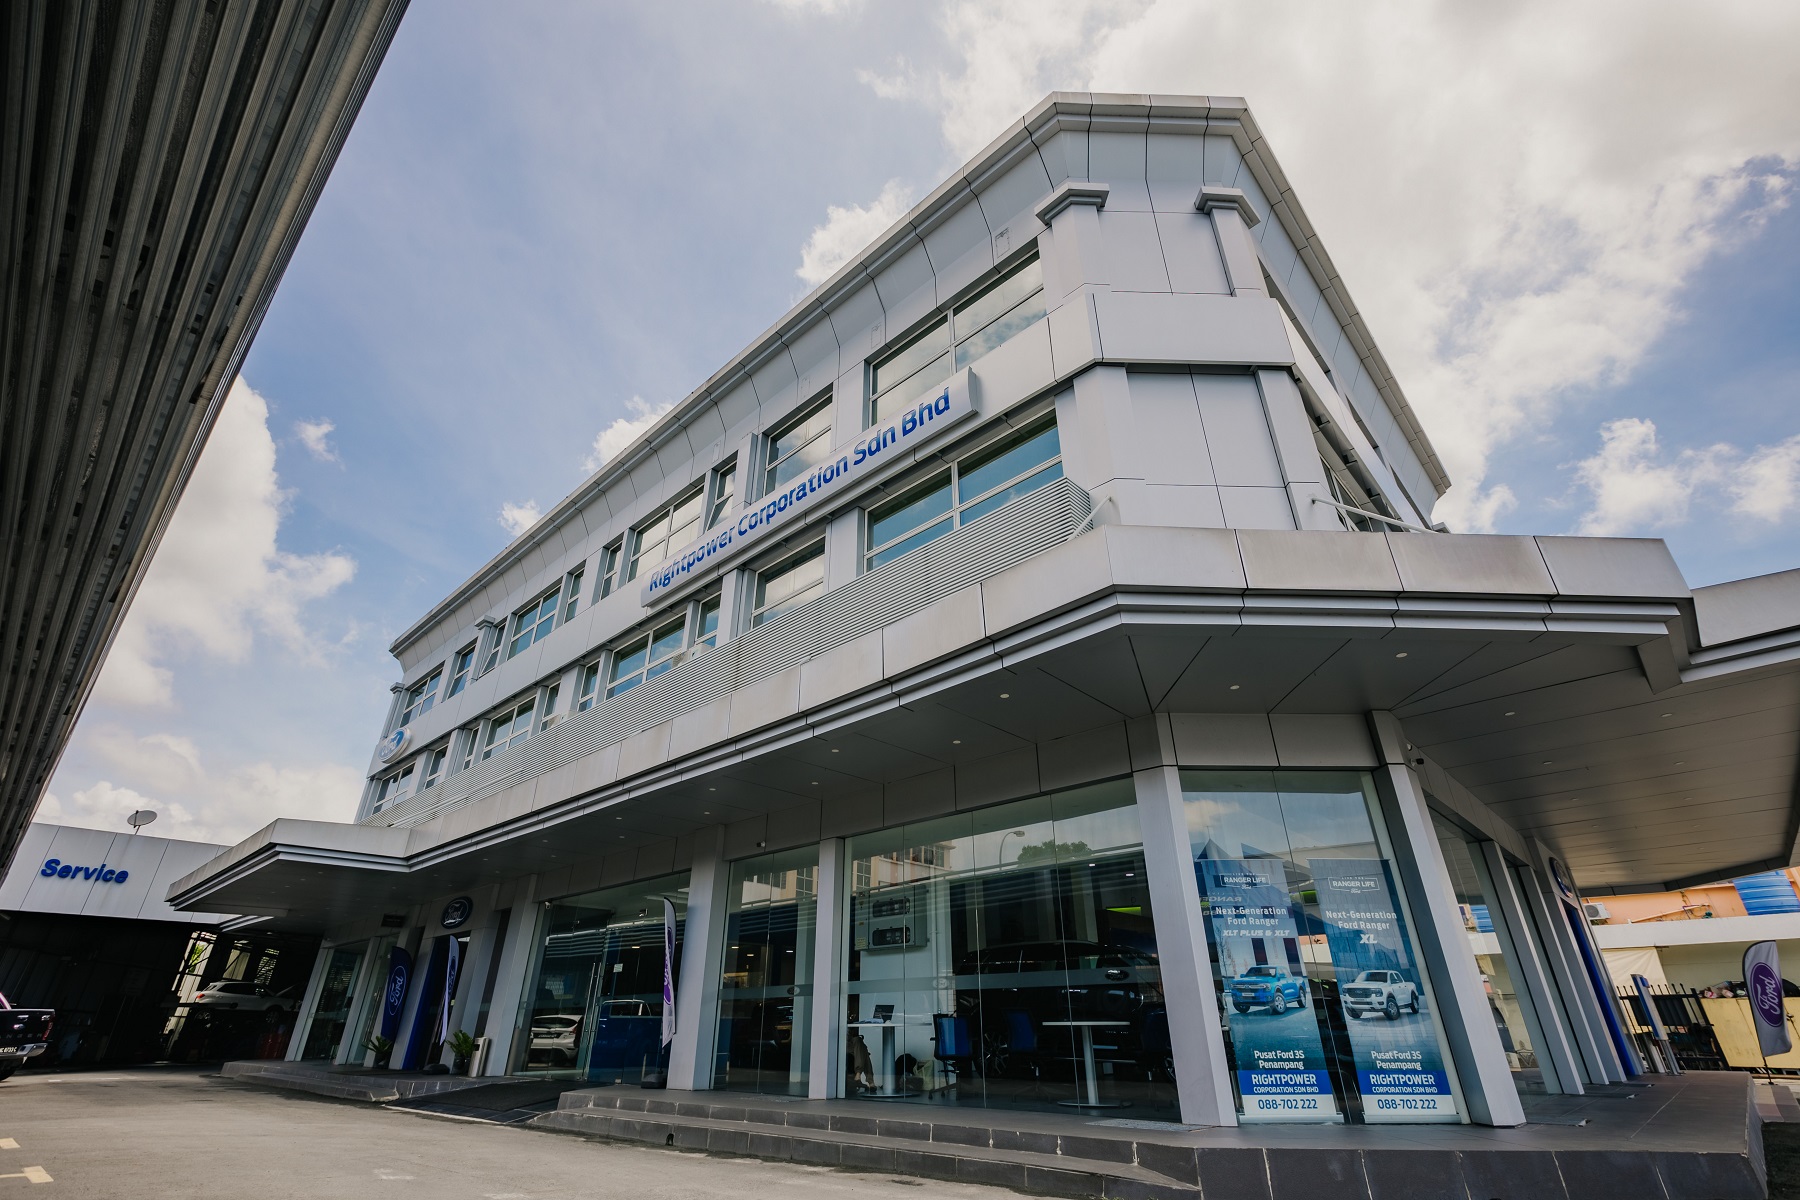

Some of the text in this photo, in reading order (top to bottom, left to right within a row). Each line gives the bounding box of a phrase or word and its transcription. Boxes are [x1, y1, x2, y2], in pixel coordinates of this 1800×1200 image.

[649, 386, 950, 592] Rightpower Corporation Sdn Bhd
[40, 858, 129, 884] Service
[1215, 907, 1287, 915] Next-Generation
[1325, 911, 1397, 919] Next-Generation
[1227, 917, 1279, 926] Ford Ranger
[1338, 921, 1390, 930] Ford Ranger
[1359, 933, 1378, 944] XL
[389, 975, 404, 1006] Ford
[1756, 974, 1781, 1015] Ford
[1254, 1050, 1305, 1059] Pusat Ford 3S
[1371, 1051, 1422, 1060] Pusat Ford 3S
[1259, 1060, 1304, 1070] Penampang
[1376, 1061, 1422, 1070] Penampang
[1251, 1074, 1317, 1085] RIGHTPOWER
[1369, 1074, 1436, 1085] RIGHTPOWER
[1258, 1099, 1318, 1110] 088-702 222
[1377, 1099, 1438, 1110] 088-702 222
